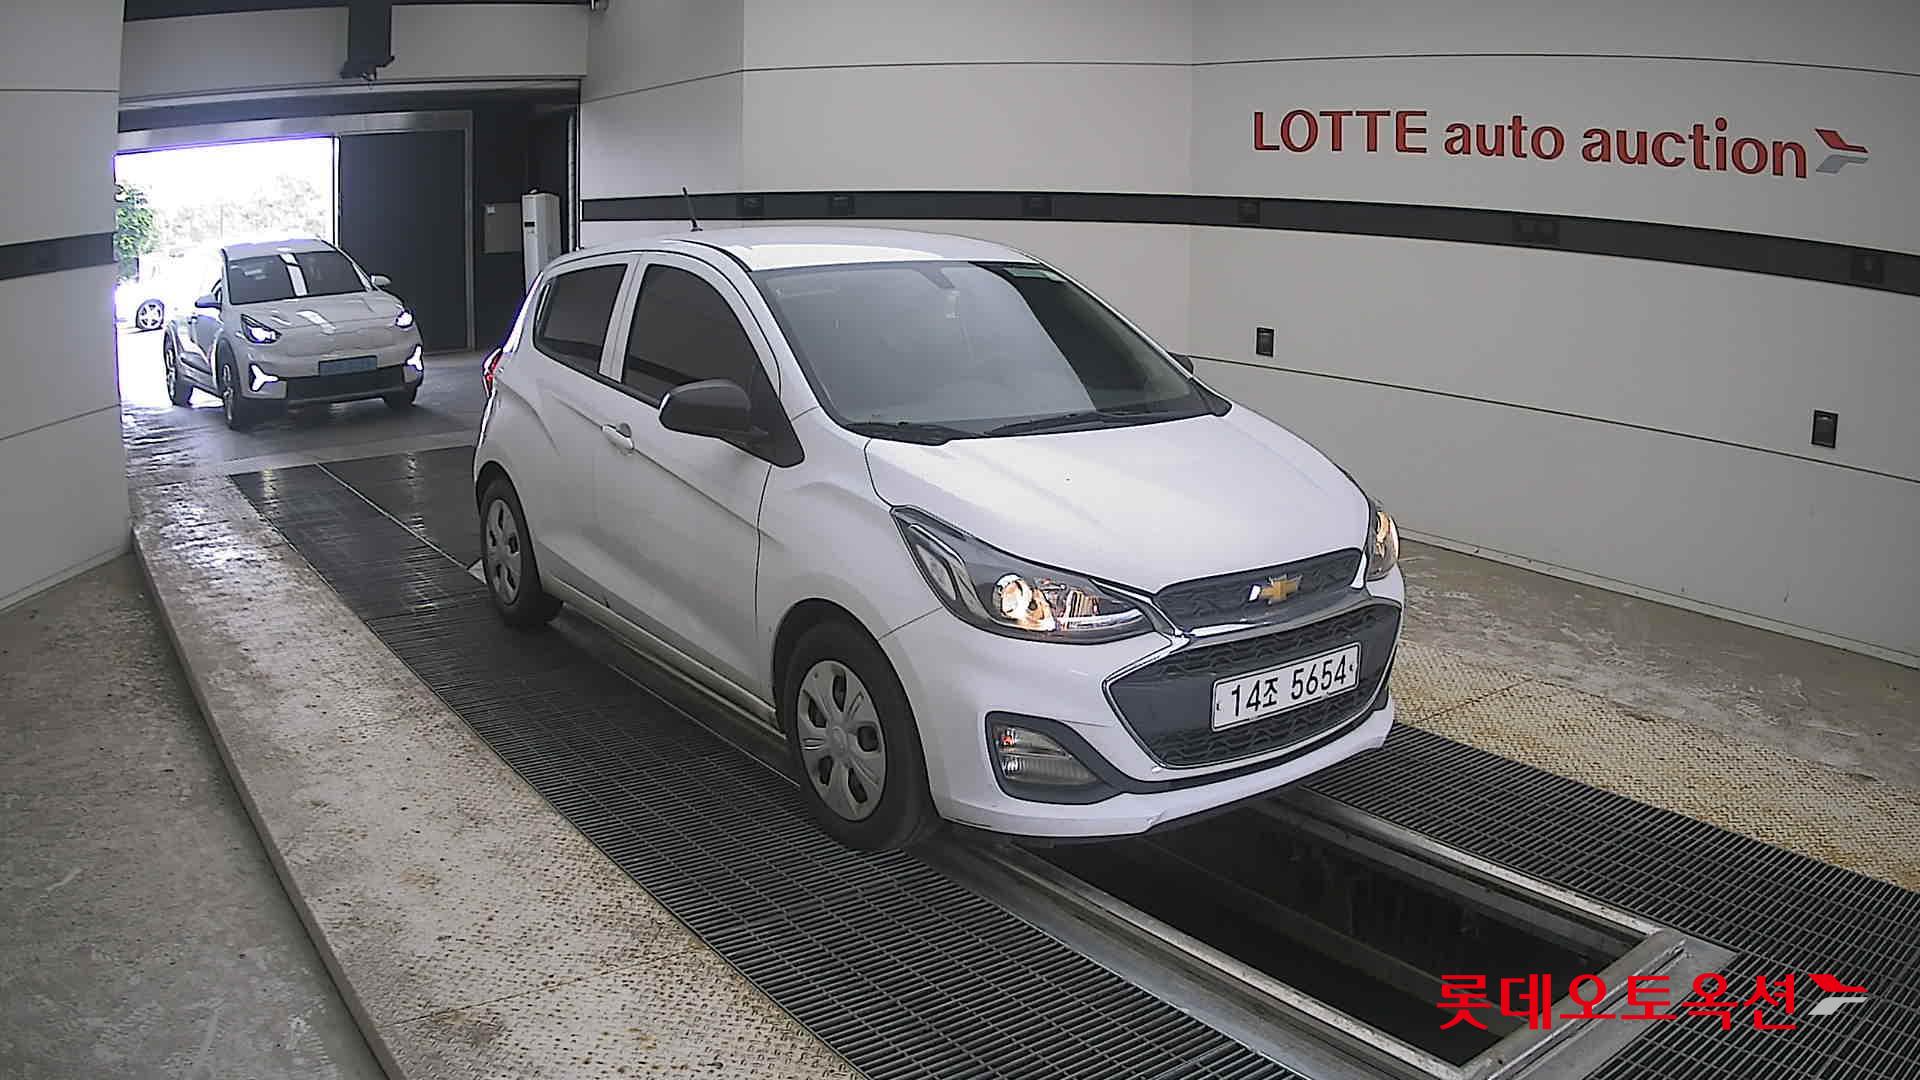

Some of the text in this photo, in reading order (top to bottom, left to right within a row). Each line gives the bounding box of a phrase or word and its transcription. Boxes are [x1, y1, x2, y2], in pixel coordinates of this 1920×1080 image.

[1253, 109, 1808, 179] LOTTE auto auction
[1231, 654, 1347, 717] 14조 5654
